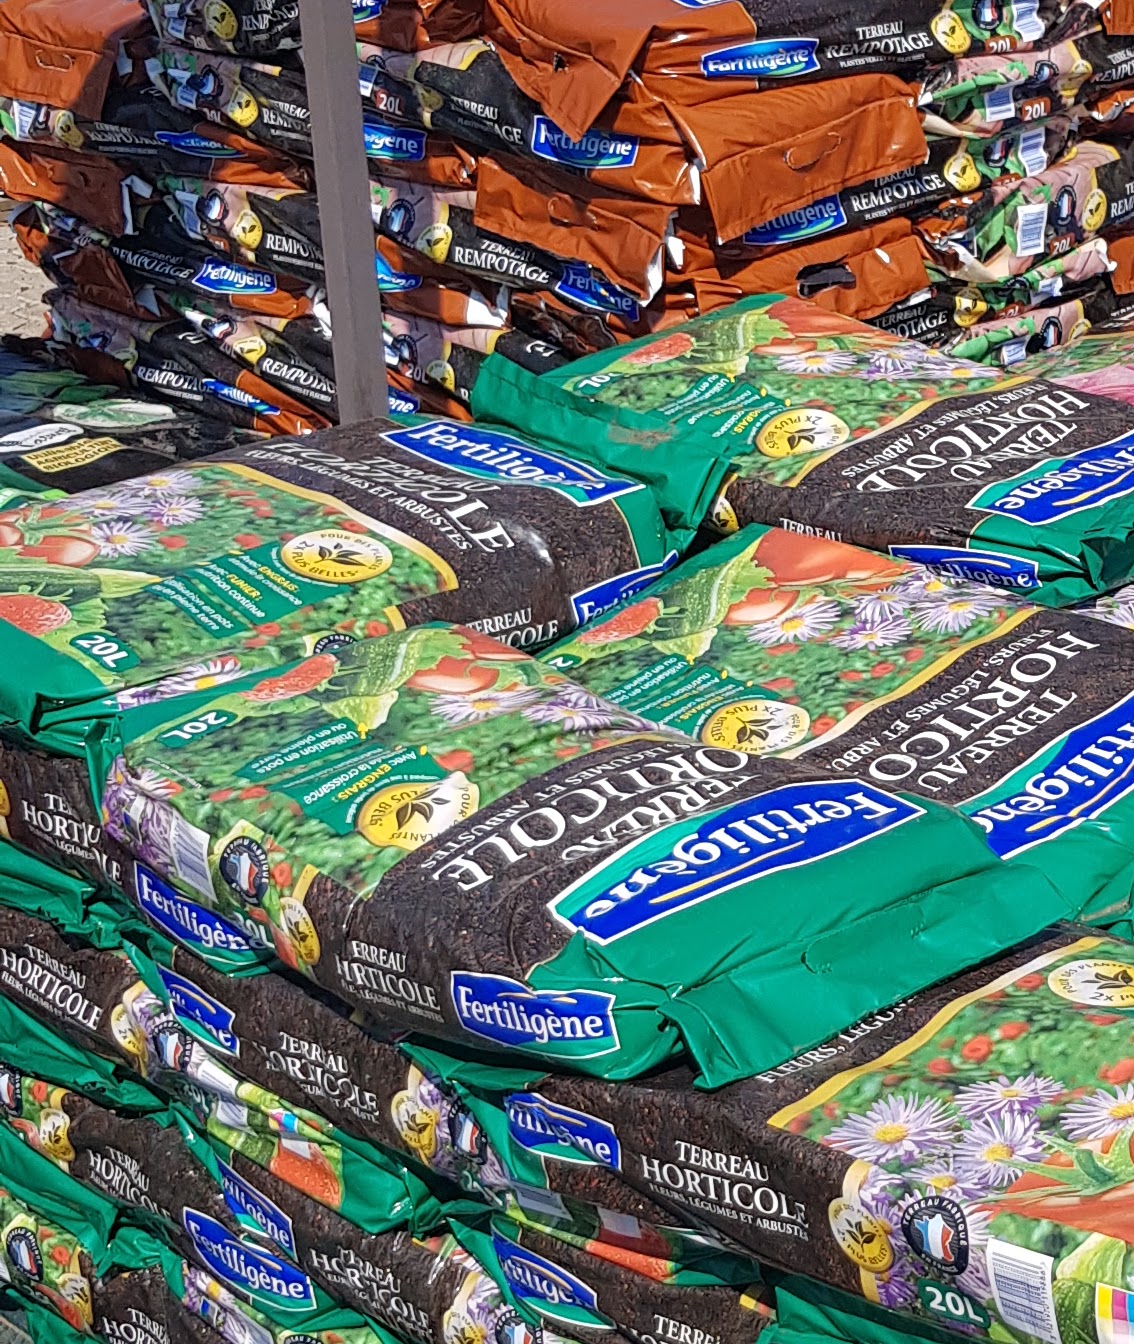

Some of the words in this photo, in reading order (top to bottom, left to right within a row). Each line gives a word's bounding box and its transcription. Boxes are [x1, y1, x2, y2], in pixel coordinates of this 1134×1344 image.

[826, 32, 935, 59] REMPOTAGE
[856, 21, 904, 41] TERREAU
[379, 93, 402, 114] 20L
[1024, 104, 1047, 121] 20L
[851, 174, 946, 212] REMPOTAGE
[454, 246, 551, 284] REMPOTAGE
[857, 389, 1091, 493] HORTICOLE
[911, 420, 937, 439] ET
[366, 456, 501, 492] TERREAU
[841, 434, 916, 479] ARBUSTES
[264, 442, 516, 553] HORTICOLE
[303, 460, 379, 491] LÉGUMES
[369, 486, 393, 504] ET
[388, 492, 474, 552] ARBUSTES
[228, 586, 266, 618] continue
[76, 634, 130, 669] 20L
[985, 628, 1056, 669] FLEURS,
[869, 631, 1101, 782] HORTICO
[904, 668, 986, 721] LÉGUMES
[884, 720, 912, 743] ET
[917, 686, 1078, 793] TERREAU
[391, 751, 417, 768] Avec
[303, 767, 358, 805] croissance
[340, 764, 392, 801] ENGRAIS
[530, 788, 555, 805] ET
[420, 798, 529, 871] ARBUSTES
[433, 747, 750, 891] ORTICOLE
[561, 774, 762, 861] TERREAU
[585, 792, 899, 919] Fertiligène
[27, 944, 88, 989] TERREAU
[0, 948, 102, 1032] HORTICOLE
[457, 985, 605, 1044] Fertiligène
[757, 1041, 846, 1085] FLEURS,
[675, 1140, 769, 1183] TERREAU
[641, 1154, 810, 1230] HORTICOLE
[649, 1181, 689, 1205] FLEURS,
[688, 1195, 739, 1222] LÉGUMES
[738, 1211, 754, 1224] ET
[188, 1219, 306, 1300] Fertiligène
[925, 1286, 984, 1324] 20L
